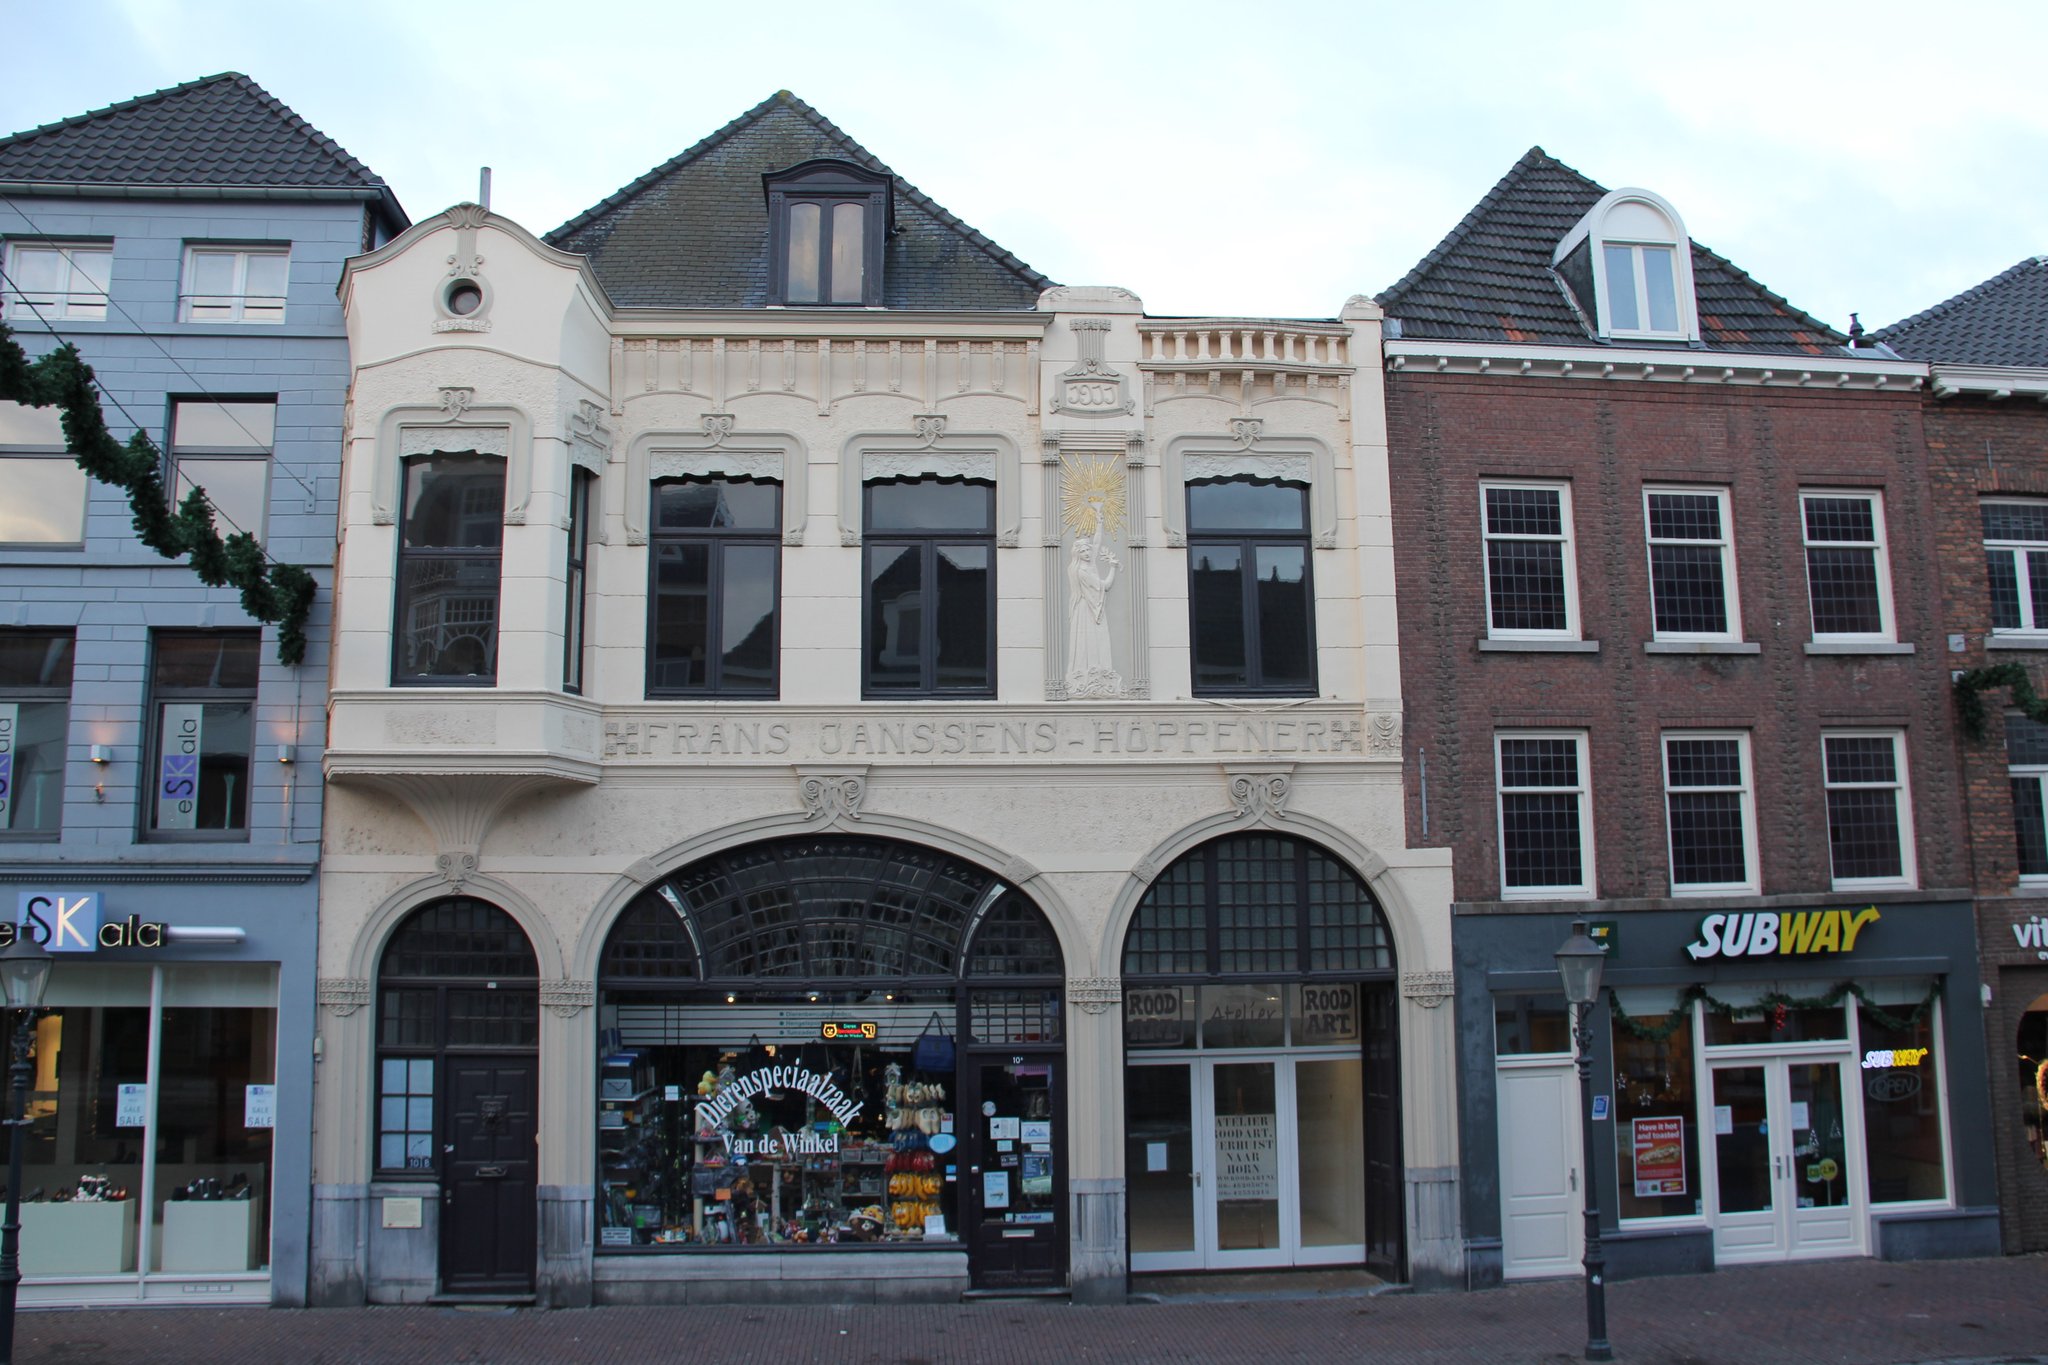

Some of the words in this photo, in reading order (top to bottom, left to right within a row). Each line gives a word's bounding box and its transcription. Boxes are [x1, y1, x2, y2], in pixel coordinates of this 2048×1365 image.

[641, 721, 792, 755] FRANS
[164, 719, 197, 814] eSKala
[1687, 905, 1881, 960] SUBWAY
[1128, 993, 1177, 1015] ROOD
[1305, 989, 1352, 1011] ROOD
[1211, 1002, 1277, 1021] Atelier
[1861, 1047, 1928, 1069] SUBWAY
[694, 1057, 865, 1130] Dierenspeciaalzaak
[118, 1115, 145, 1126] SALE
[246, 1116, 273, 1126] SALE
[1215, 1116, 1269, 1127] ATELIER
[1657, 1122, 1664, 1130] it
[1664, 1121, 1678, 1130] hot
[722, 1133, 755, 1154] Van
[758, 1133, 779, 1154] de
[780, 1133, 839, 1154] Winkel
[1637, 1132, 1652, 1140] and
[1652, 1130, 1680, 1139] toasted
[1226, 1152, 1260, 1162] NAAR
[1226, 1163, 1260, 1174] HORN
